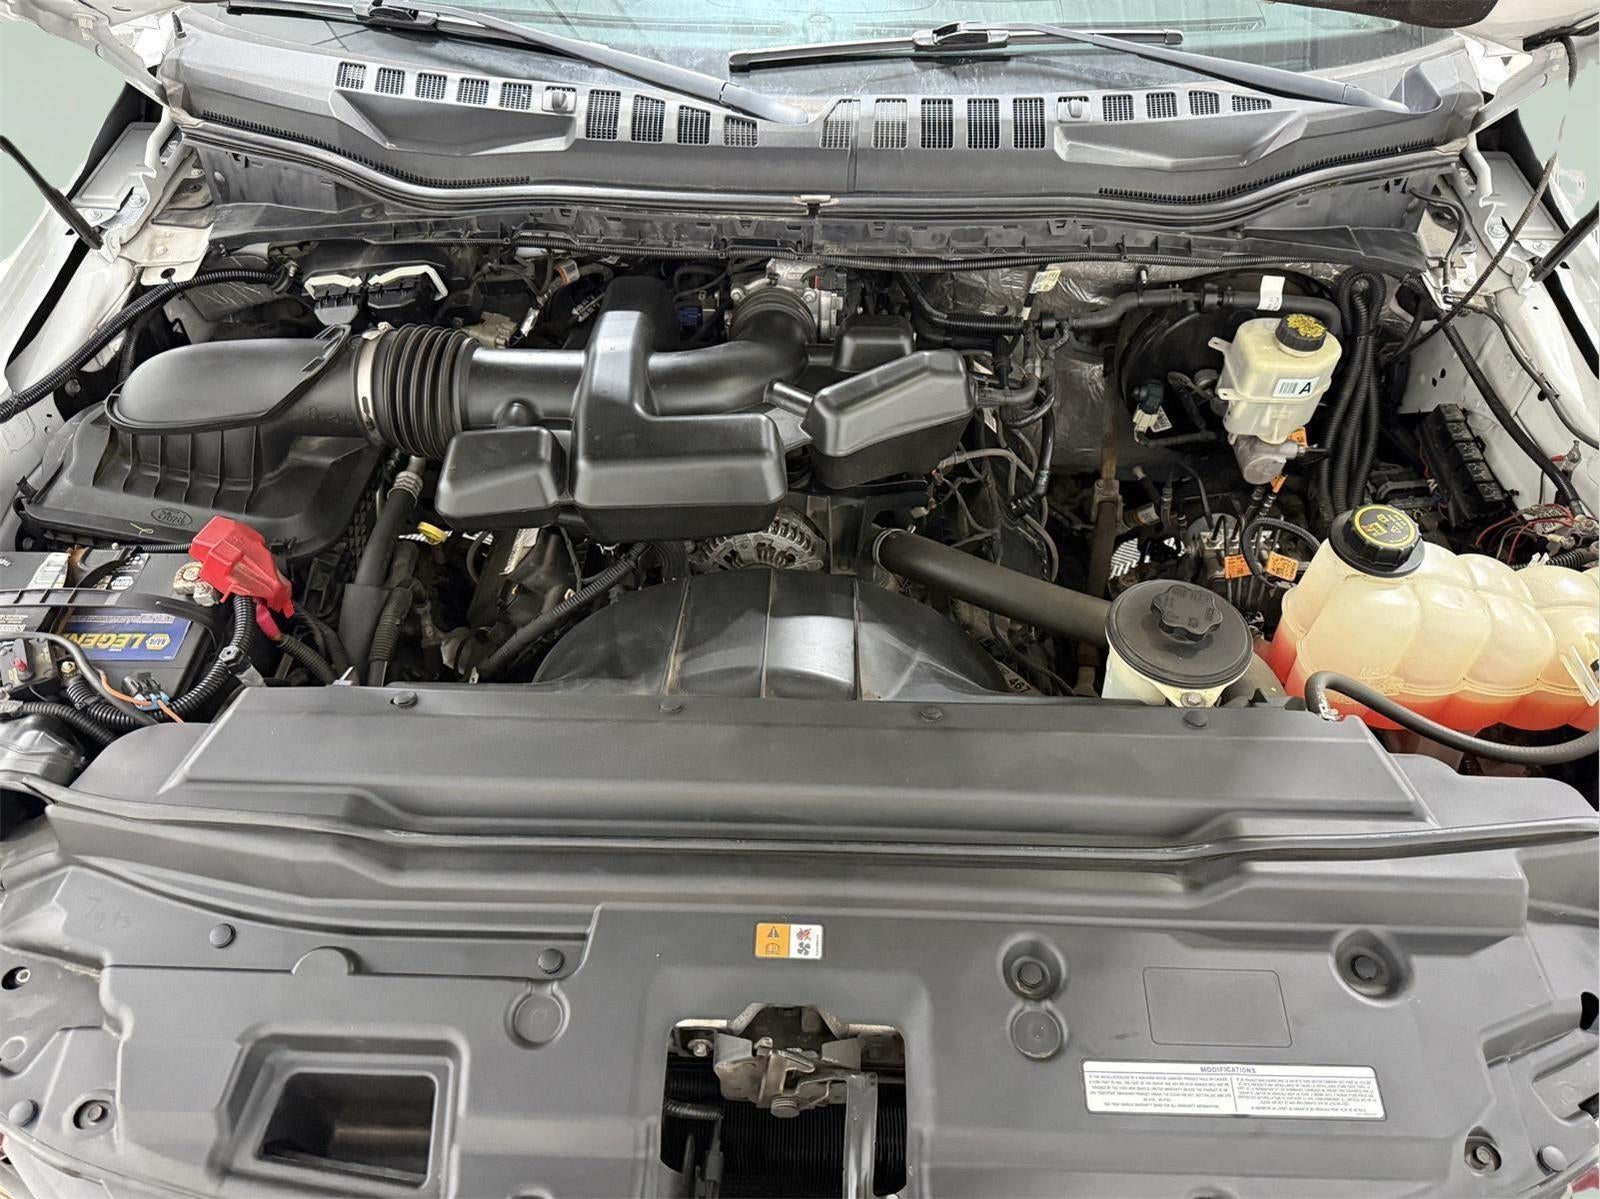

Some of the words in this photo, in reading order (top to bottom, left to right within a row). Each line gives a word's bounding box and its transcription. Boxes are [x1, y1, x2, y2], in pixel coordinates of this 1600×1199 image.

[1299, 381, 1311, 395] A
[158, 510, 186, 526] Ford
[66, 633, 147, 649] LEGEN
[1200, 1066, 1256, 1074] MODIFICATIONS
